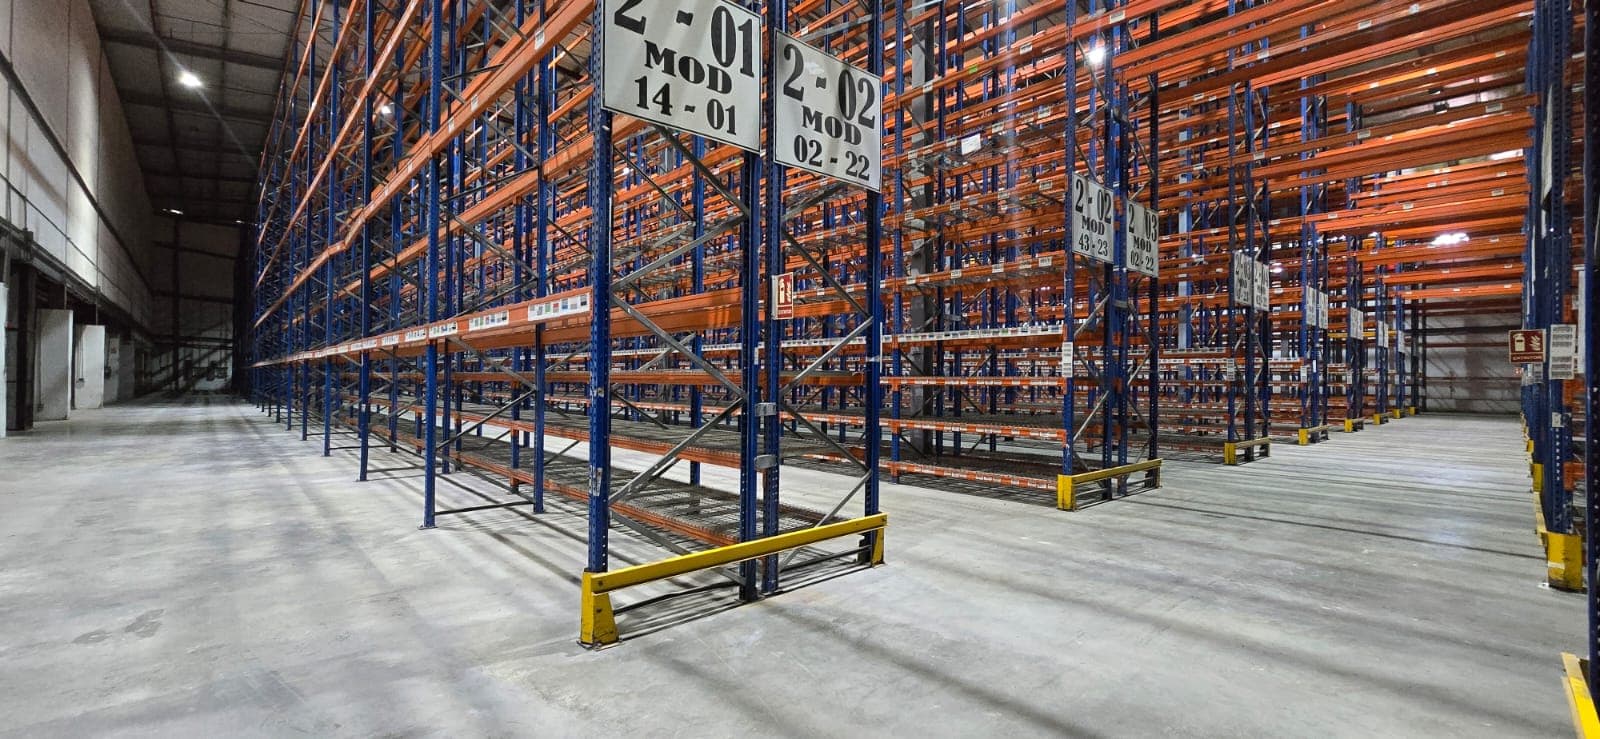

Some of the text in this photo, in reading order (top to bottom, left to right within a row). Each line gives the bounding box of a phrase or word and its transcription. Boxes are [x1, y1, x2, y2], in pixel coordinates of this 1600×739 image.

[711, 5, 755, 78] 01
[644, 40, 733, 95] MOD
[783, 43, 804, 102] 2
[838, 69, 876, 129] 02
[635, 76, 673, 116] 14
[707, 98, 737, 136] 01
[801, 105, 862, 146] MOD
[793, 134, 823, 167] 02
[845, 150, 870, 181] 22
[1075, 179, 1084, 213] 2
[1097, 189, 1112, 224] 02
[1128, 203, 1157, 242] 2 03
[1078, 234, 1090, 251] 43
[1097, 239, 1108, 256] 23
[1081, 216, 1105, 236] MOD
[1133, 236, 1152, 253] MOD
[1130, 250, 1140, 266] 02
[1145, 256, 1154, 271] 22
